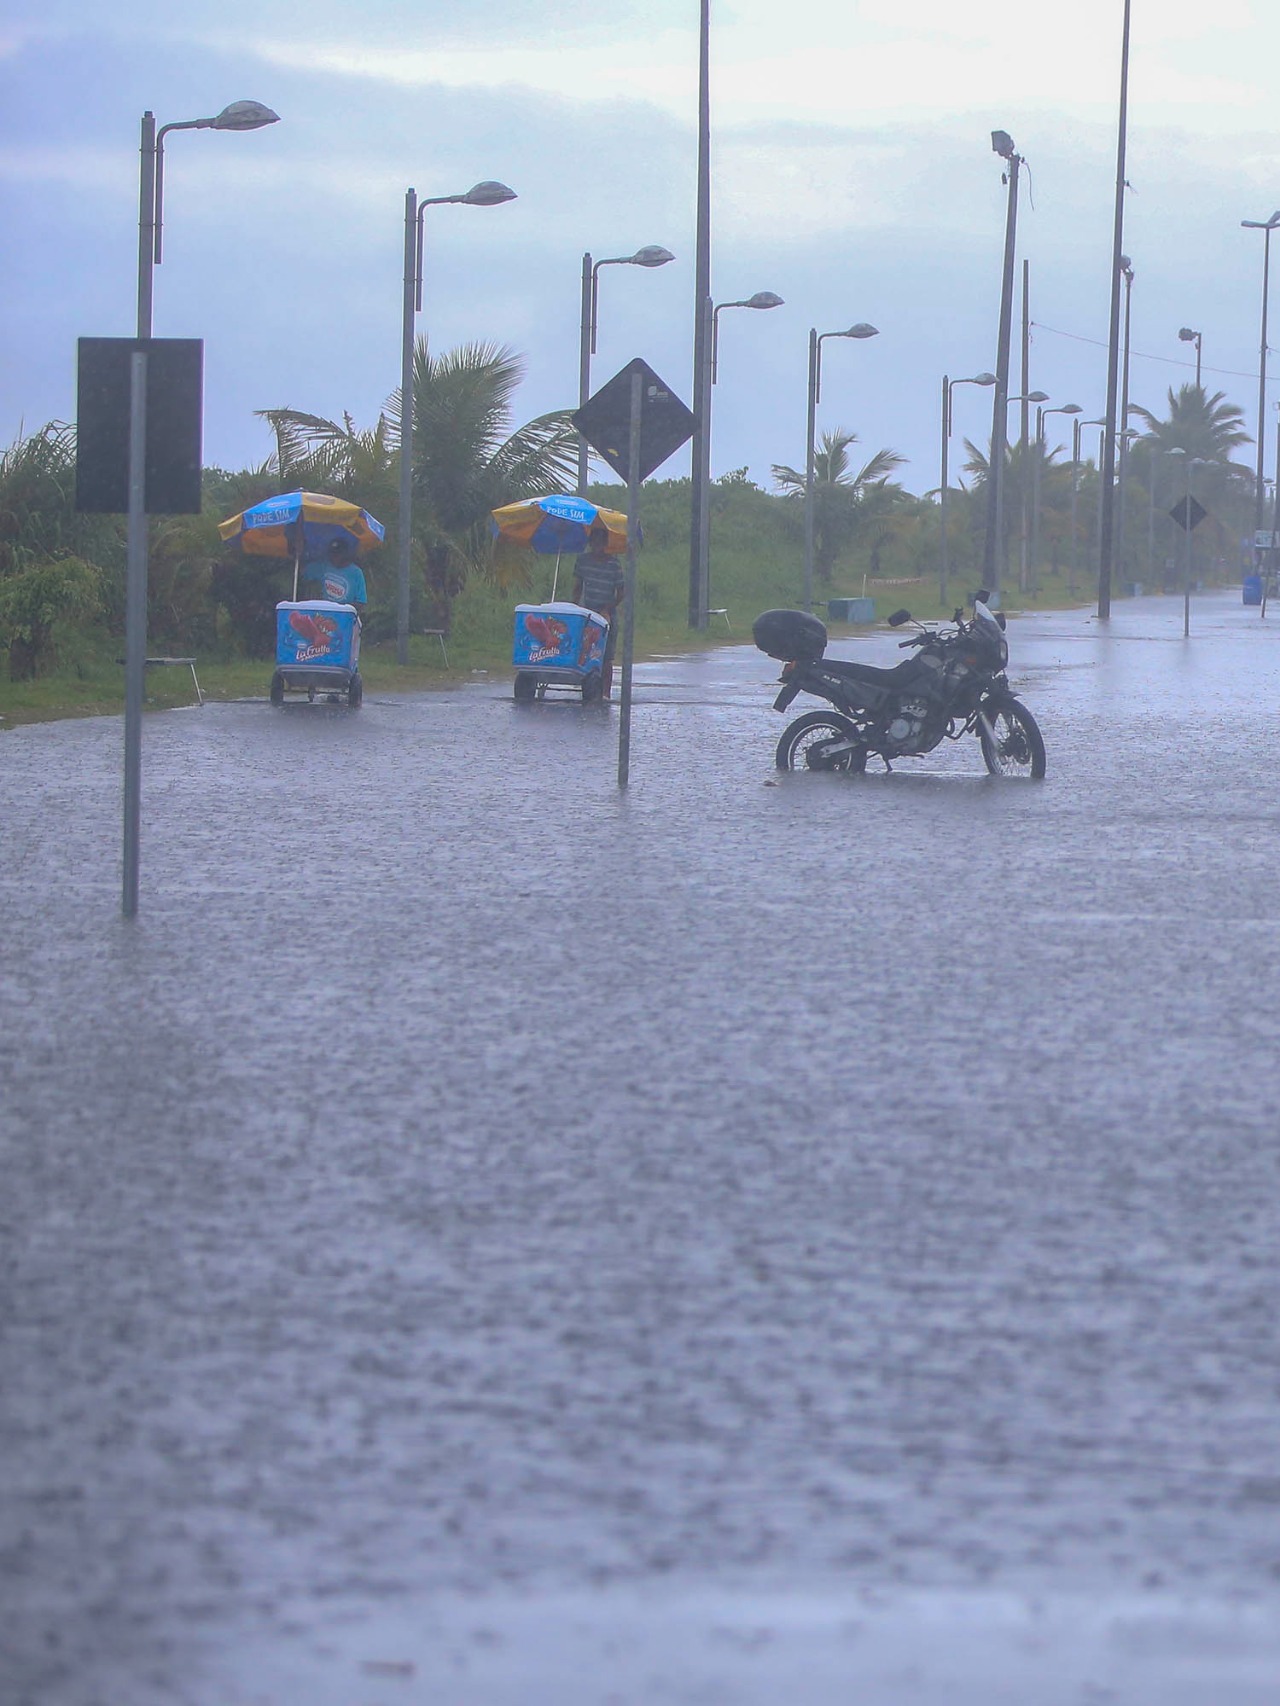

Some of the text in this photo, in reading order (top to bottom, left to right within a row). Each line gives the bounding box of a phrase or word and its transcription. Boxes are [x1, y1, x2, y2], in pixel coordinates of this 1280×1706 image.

[252, 508, 290, 524] PODE SIM
[546, 505, 585, 520] PODE SIM
